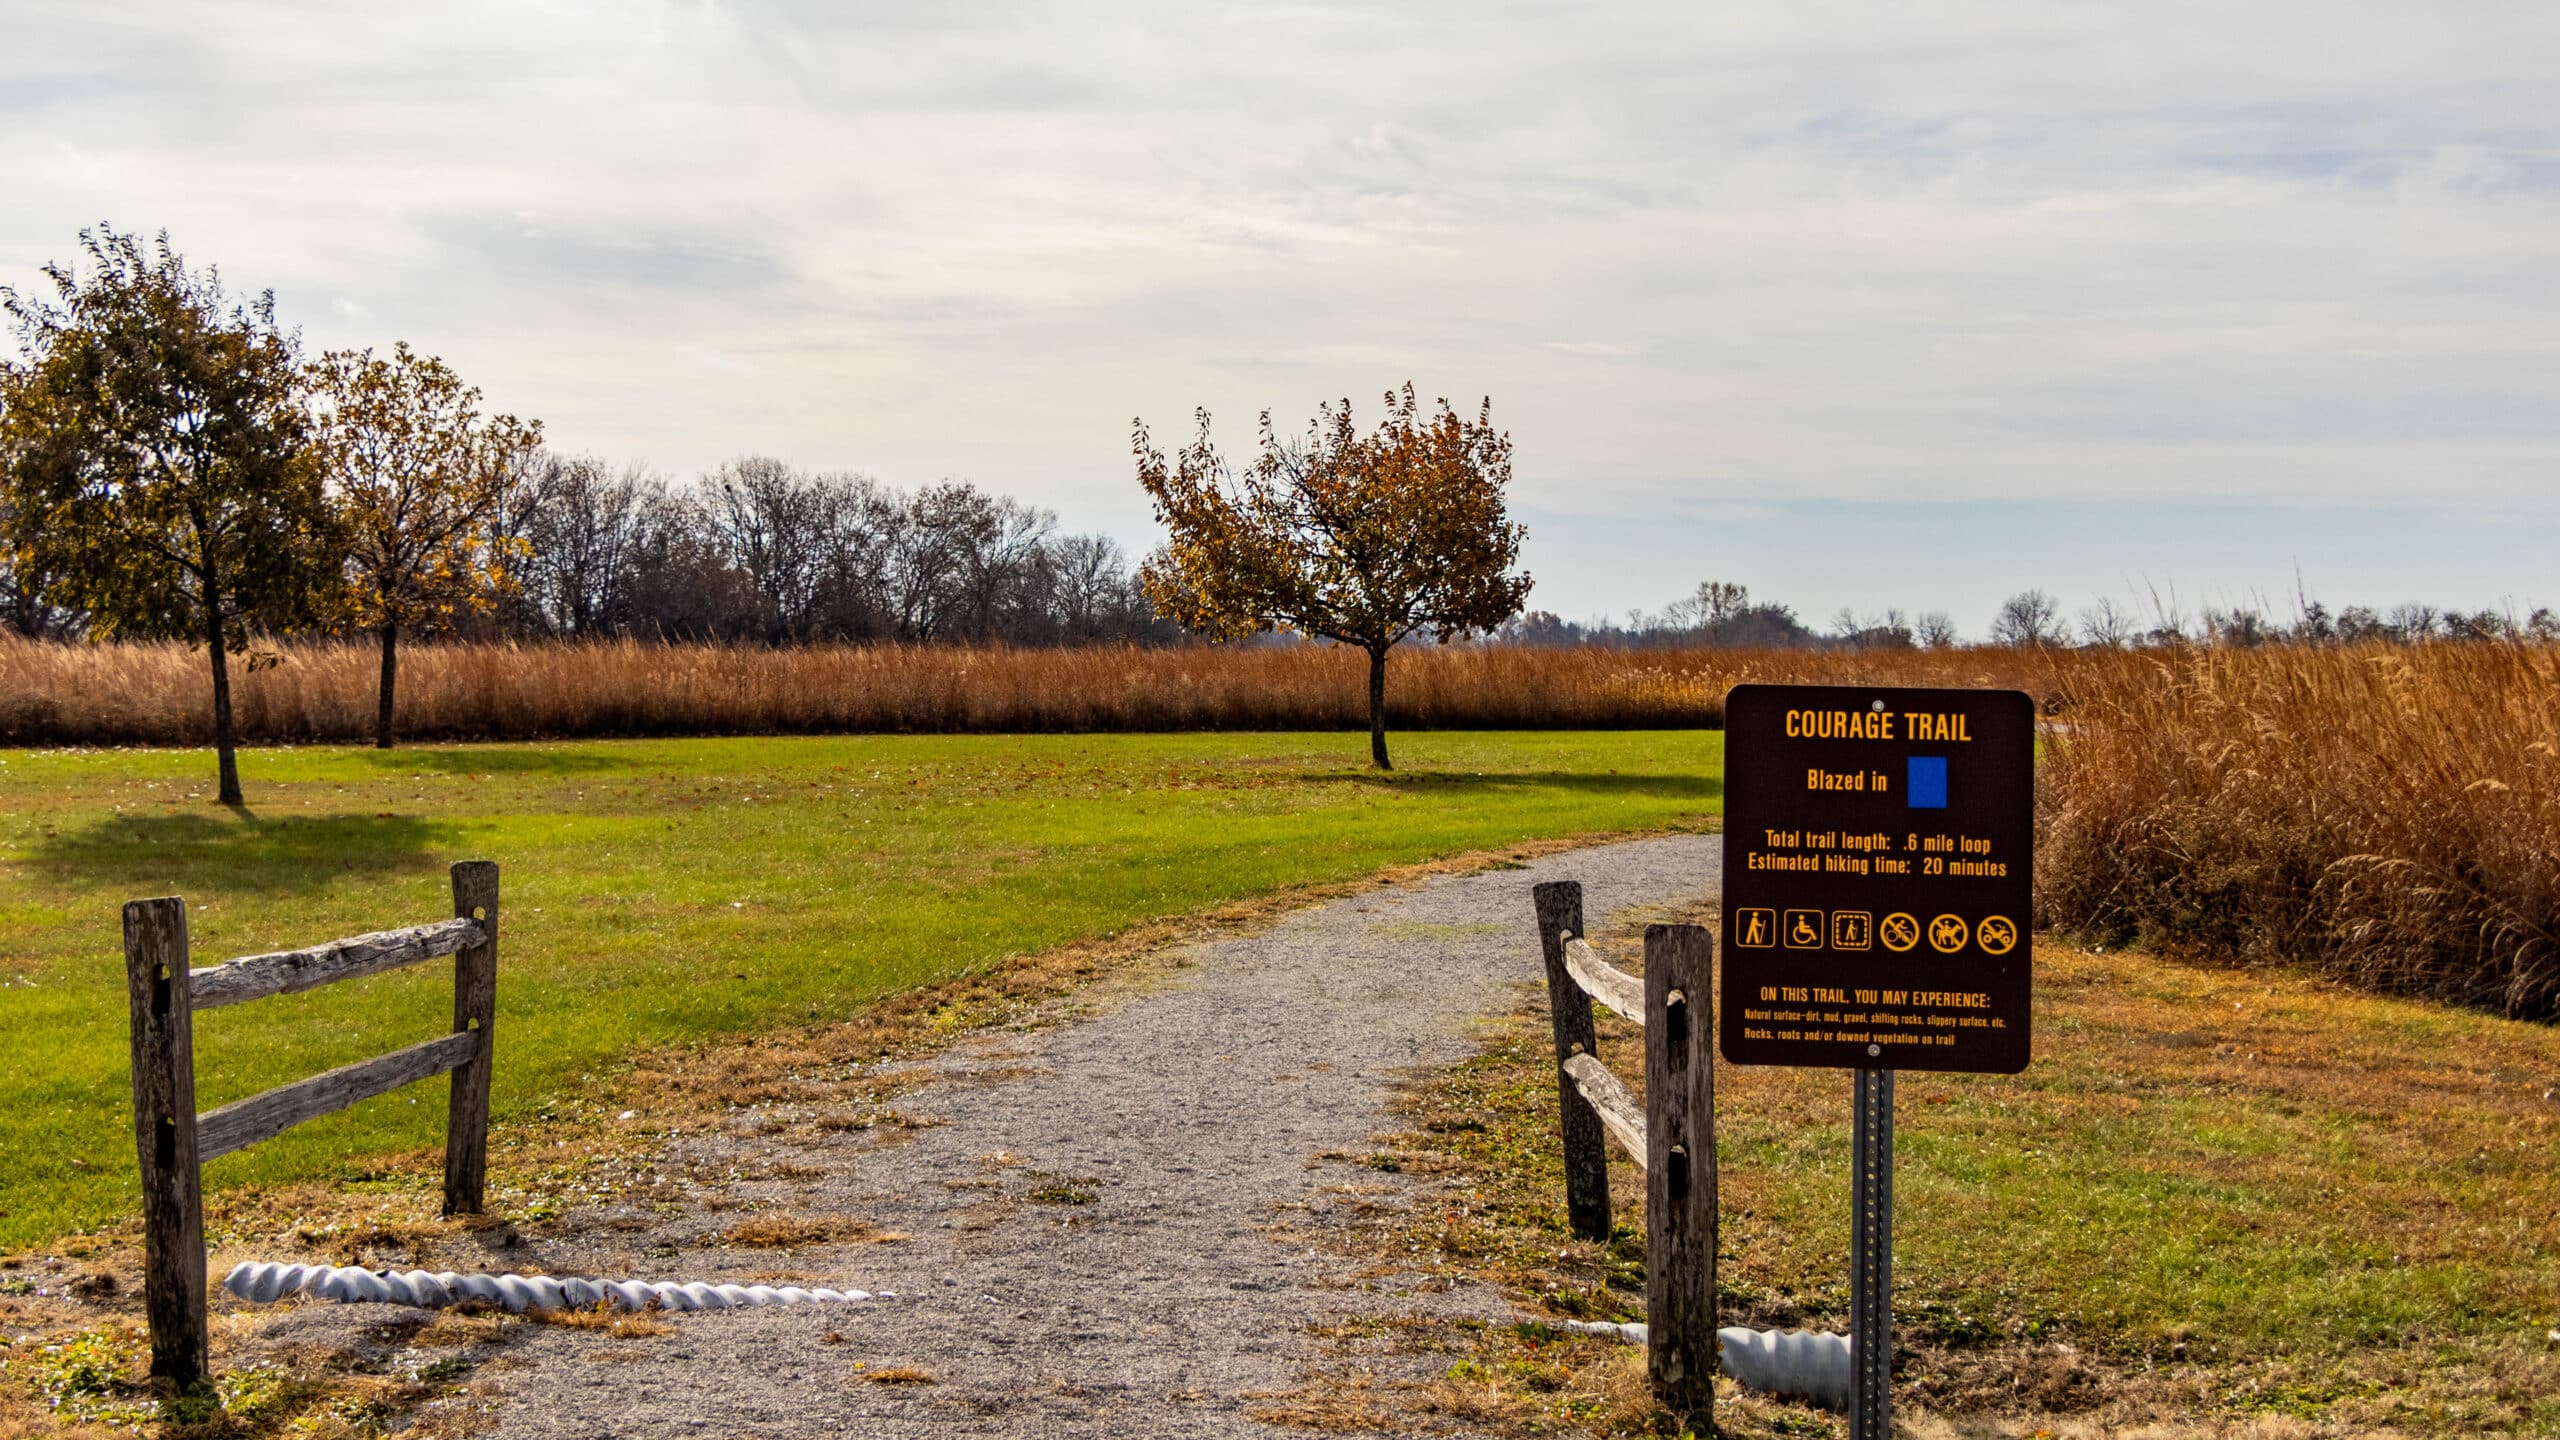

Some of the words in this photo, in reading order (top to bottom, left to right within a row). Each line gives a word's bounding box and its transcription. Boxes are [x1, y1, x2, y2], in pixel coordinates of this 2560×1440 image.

[1786, 709, 1894, 740] COURAGE
[1904, 712, 1972, 741] TRAIL
[1807, 769, 1864, 791] Blazed
[1872, 770, 1888, 792] in
[1765, 829, 1799, 848] Total
[1806, 831, 1835, 849] trail
[1842, 832, 1891, 853] length:
[1903, 833, 1918, 851] .6
[1924, 834, 1954, 852] mile
[1960, 835, 1991, 856] loop
[1748, 852, 1819, 871] Estimated
[1826, 854, 1869, 875] hiking
[1875, 856, 1911, 874] time:
[1923, 857, 1943, 875] 20
[1949, 858, 2007, 877] minutes
[1760, 986, 1777, 1001] ON
[1781, 987, 1808, 1002] THIS
[1855, 989, 1878, 1004] YOU
[1883, 990, 1908, 1005] MAY
[1912, 991, 1991, 1008] EXPERIENCE:
[1744, 1008, 1771, 1020] Natural
[1871, 1012, 1899, 1026] shifting
[1927, 1014, 1957, 1028] slippery
[1778, 1030, 1801, 1041] roots
[1804, 1030, 1833, 1041] and/or
[1836, 1031, 1870, 1042] downed
[1873, 1033, 1919, 1045] vegetation
[1922, 1035, 1933, 1045] on
[1936, 1034, 1956, 1046] trail
